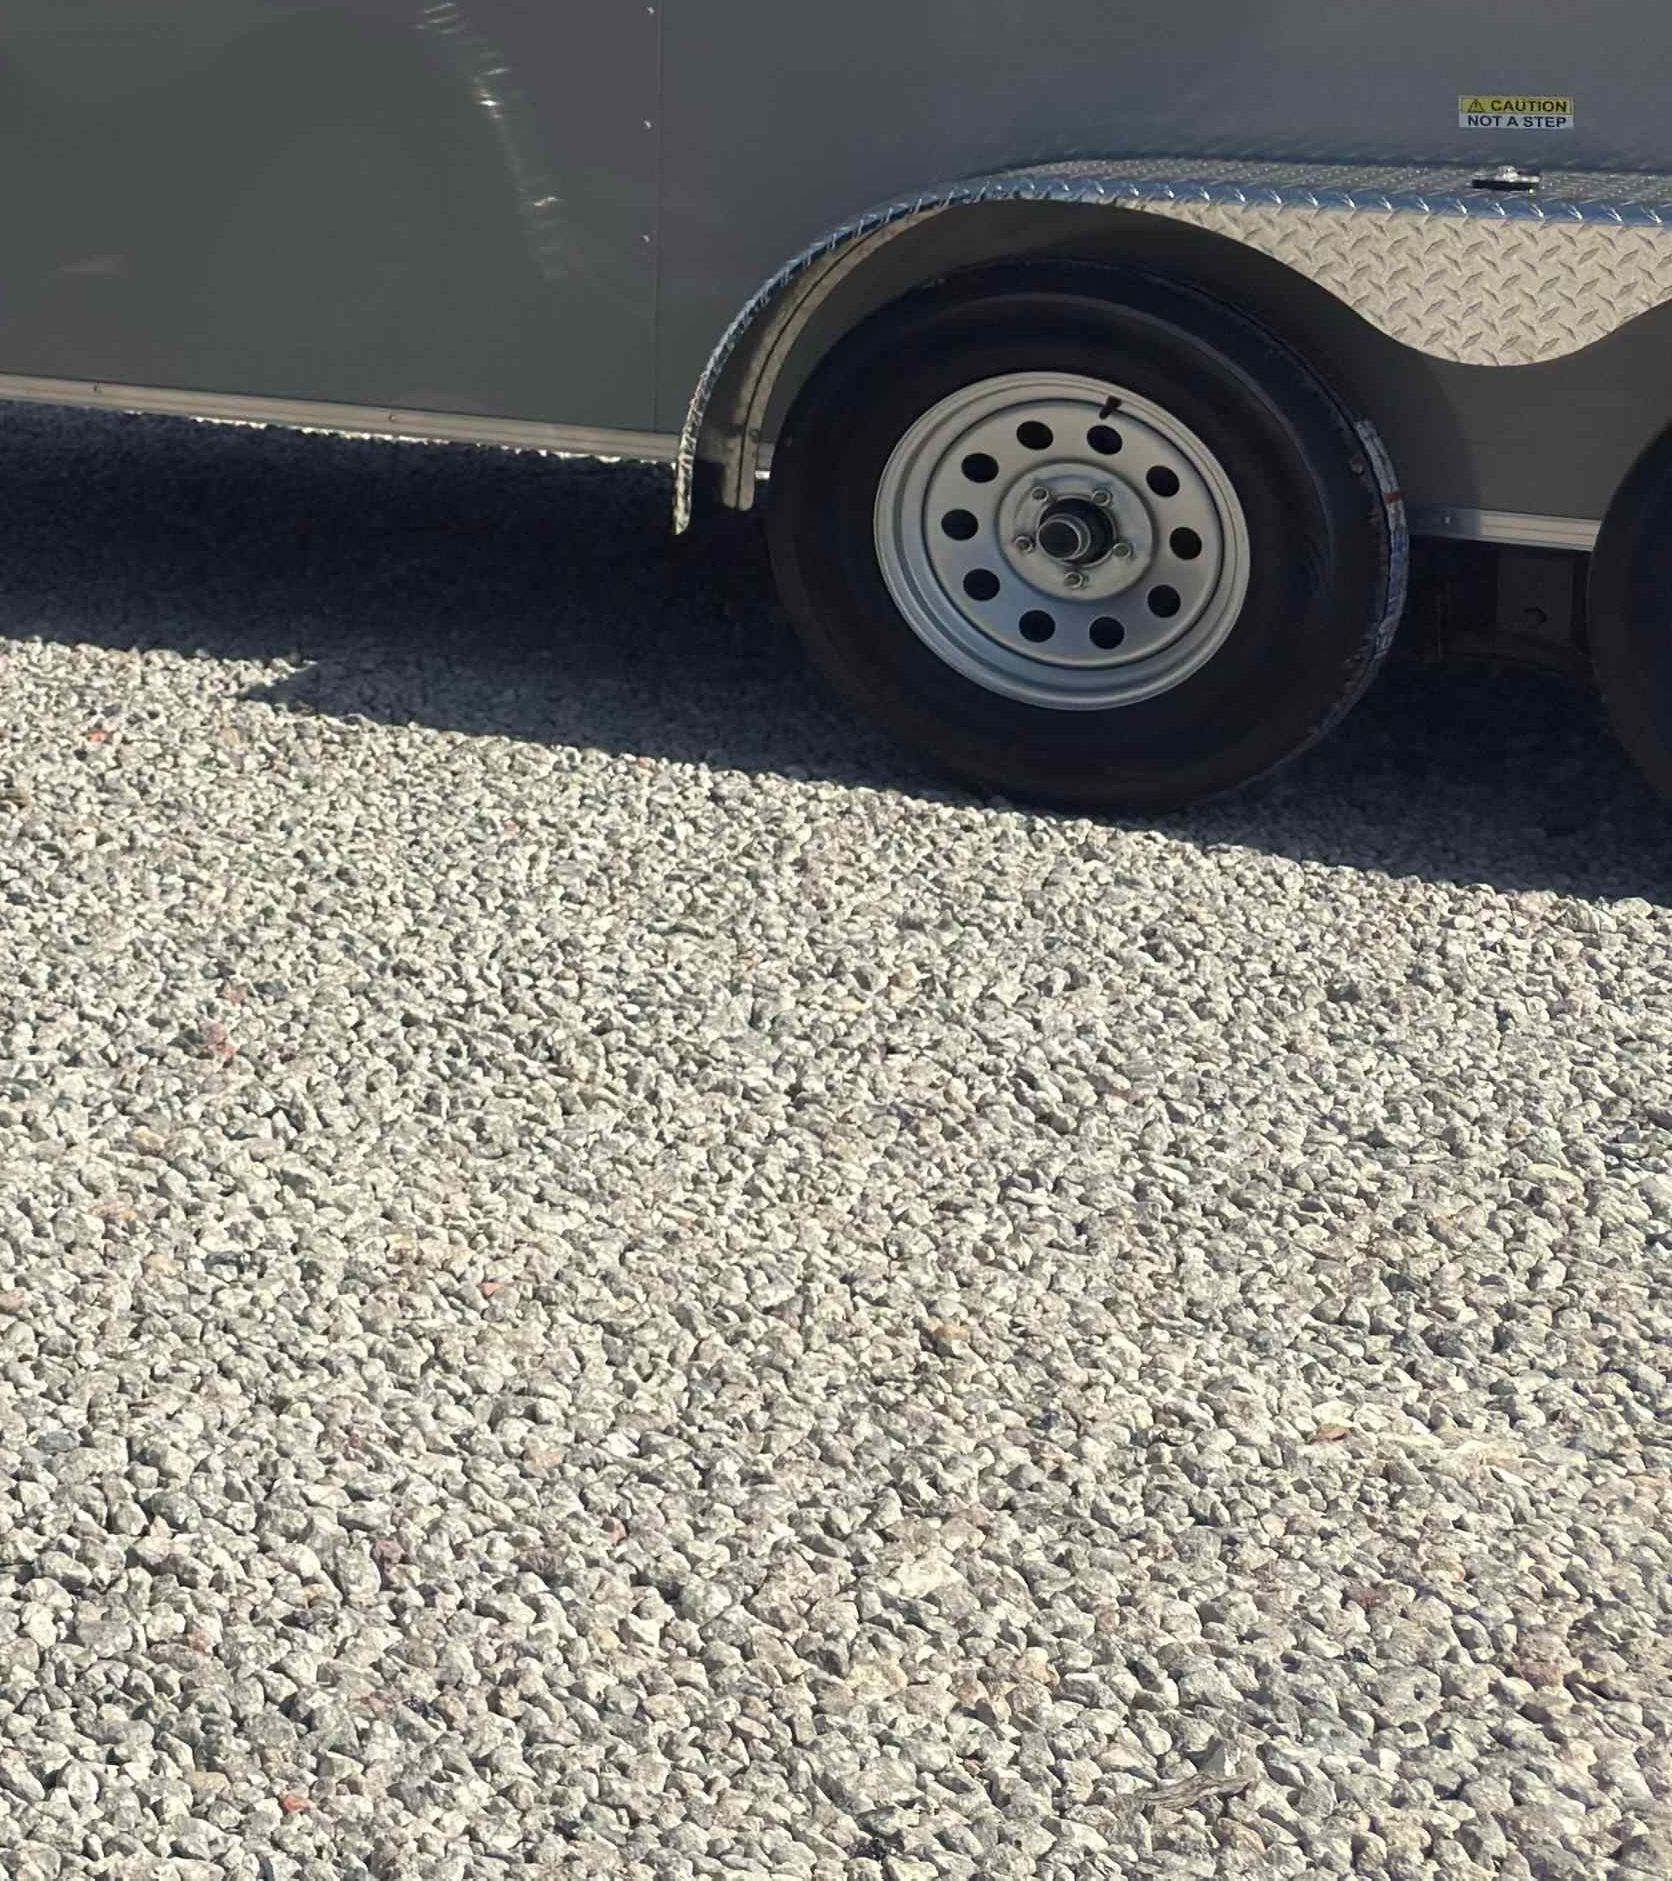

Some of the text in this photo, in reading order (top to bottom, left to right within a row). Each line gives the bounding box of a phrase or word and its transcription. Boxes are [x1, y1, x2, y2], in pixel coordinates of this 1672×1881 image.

[1491, 100, 1567, 113] CAUTION
[1467, 114, 1566, 128] NOT A STEP
